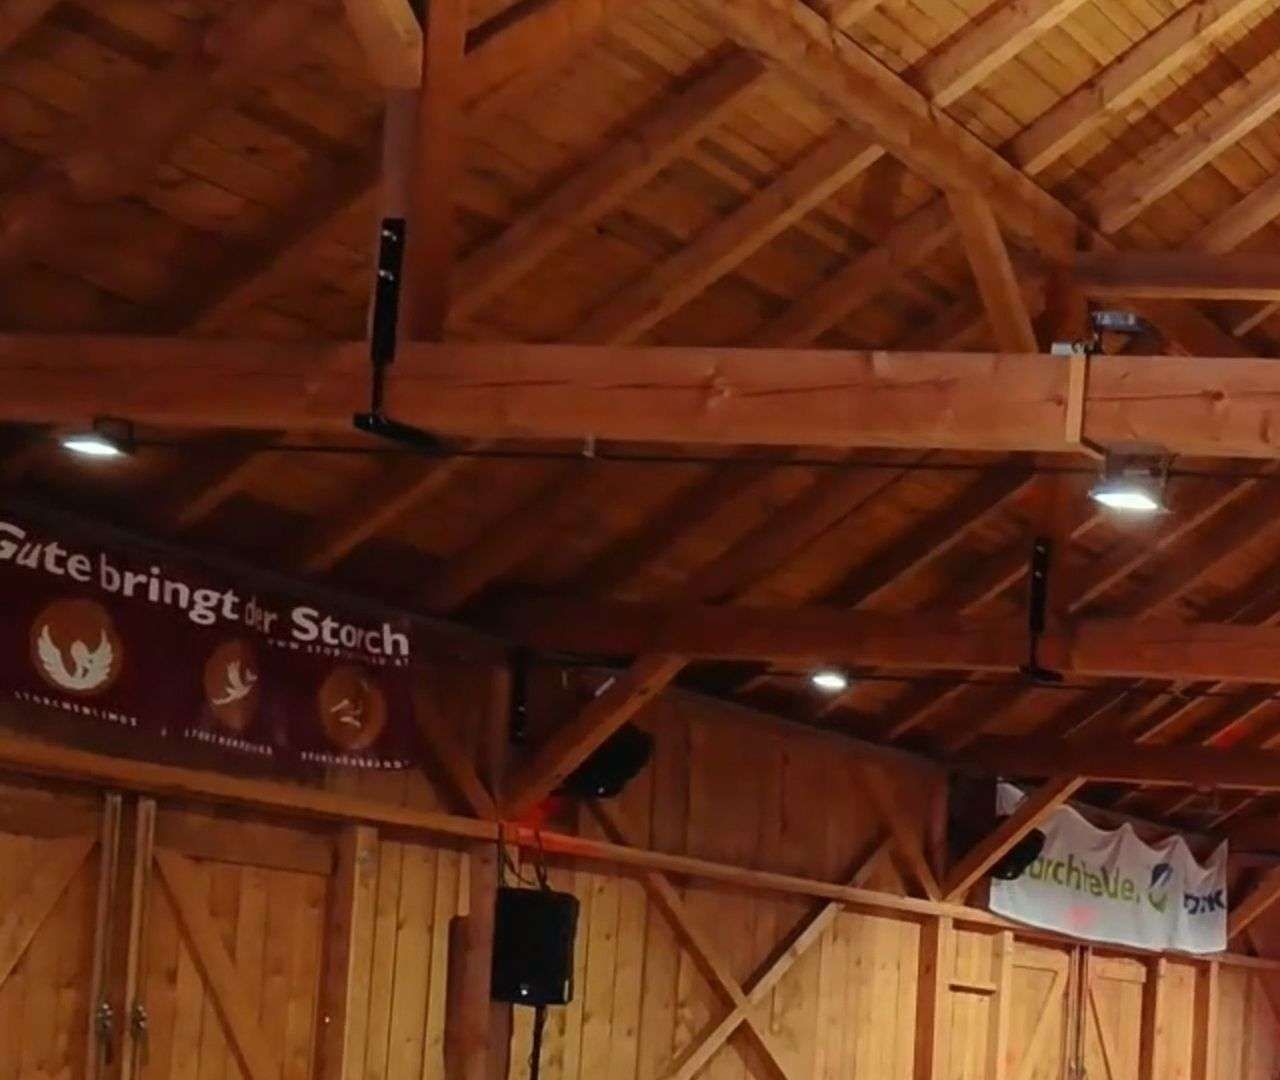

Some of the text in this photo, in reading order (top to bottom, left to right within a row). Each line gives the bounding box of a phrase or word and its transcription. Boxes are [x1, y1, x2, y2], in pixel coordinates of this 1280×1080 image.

[0, 521, 92, 582] Gute
[100, 552, 240, 625] bringt
[244, 595, 277, 634] der
[291, 606, 409, 656] Storch
